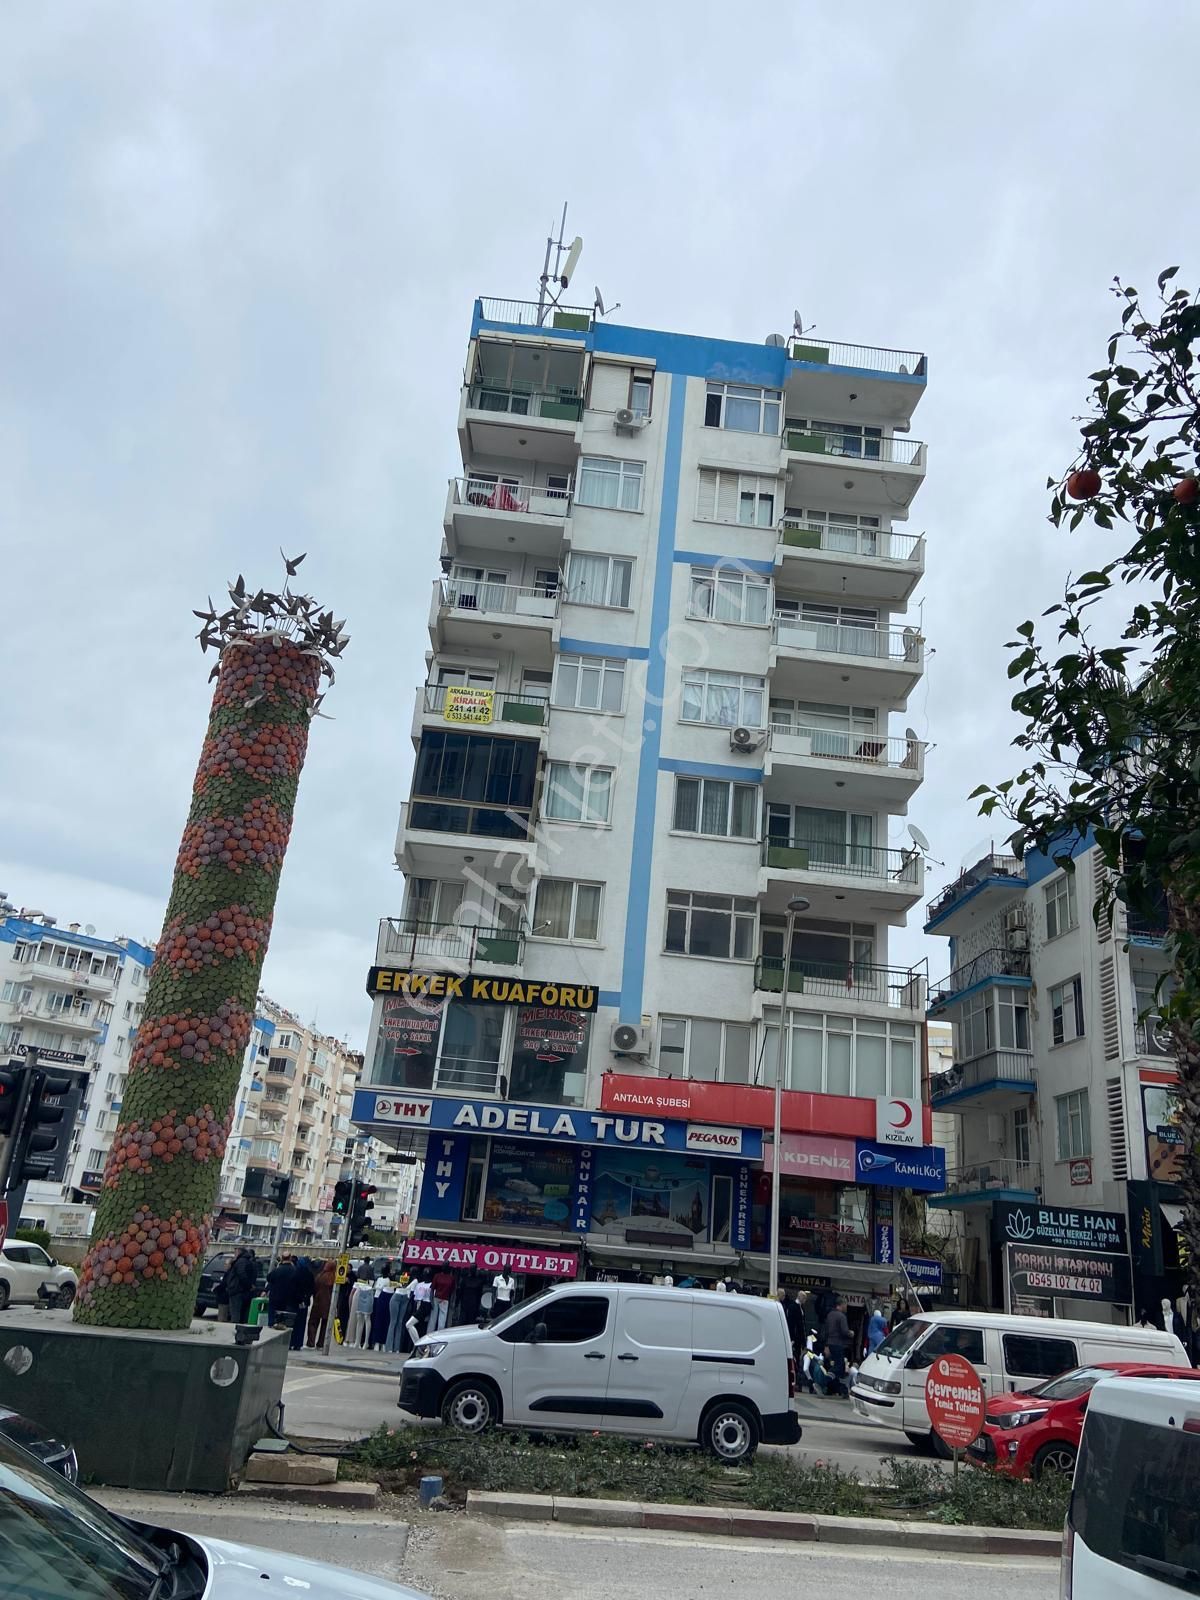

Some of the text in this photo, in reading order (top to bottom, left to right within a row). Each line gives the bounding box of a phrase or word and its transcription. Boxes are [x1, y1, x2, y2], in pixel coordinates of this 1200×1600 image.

[453, 696, 487, 706] KİRALIK
[376, 970, 595, 1009] ERKEK KUAFÖRÜ
[384, 1017, 440, 1032] ERKEK KUAFÖRÜ
[521, 1008, 588, 1029] MERKEZ
[386, 1031, 400, 1042] SAÇ
[410, 1033, 432, 1043] SAKAL
[520, 1027, 585, 1041] ERKEK KUAFÖRÜ
[523, 1040, 539, 1051] SAÇ
[552, 1043, 577, 1054] SAKAL
[613, 1092, 691, 1109] ANTALYA ŞUBESİ
[393, 1102, 430, 1118] THY
[453, 1104, 666, 1145] ADELA TUR
[688, 1132, 739, 1147] PEGASUS
[885, 1133, 914, 1143] KIZILAY
[435, 1140, 454, 1198] THY
[576, 1150, 591, 1228] ONURAIR
[738, 1167, 748, 1242] SUNEXPRESS
[1039, 1210, 1116, 1231] BLUE HAN
[1036, 1226, 1065, 1238] GÜZELLİK
[1066, 1228, 1093, 1240] MERKEZİ
[1097, 1232, 1107, 1242] VIP
[1109, 1234, 1120, 1243] SPA
[406, 1244, 574, 1273] BAYAN OUTLET
[1015, 1252, 1113, 1277] KORKU İSTASYONU
[785, 1276, 826, 1287] AVANTAJ
[1029, 1273, 1052, 1287] 0545
[1055, 1275, 1070, 1288] 107
[1089, 1278, 1100, 1292] 07
[928, 1378, 982, 1404] Çevremizi
[934, 1397, 954, 1411] Temiz
